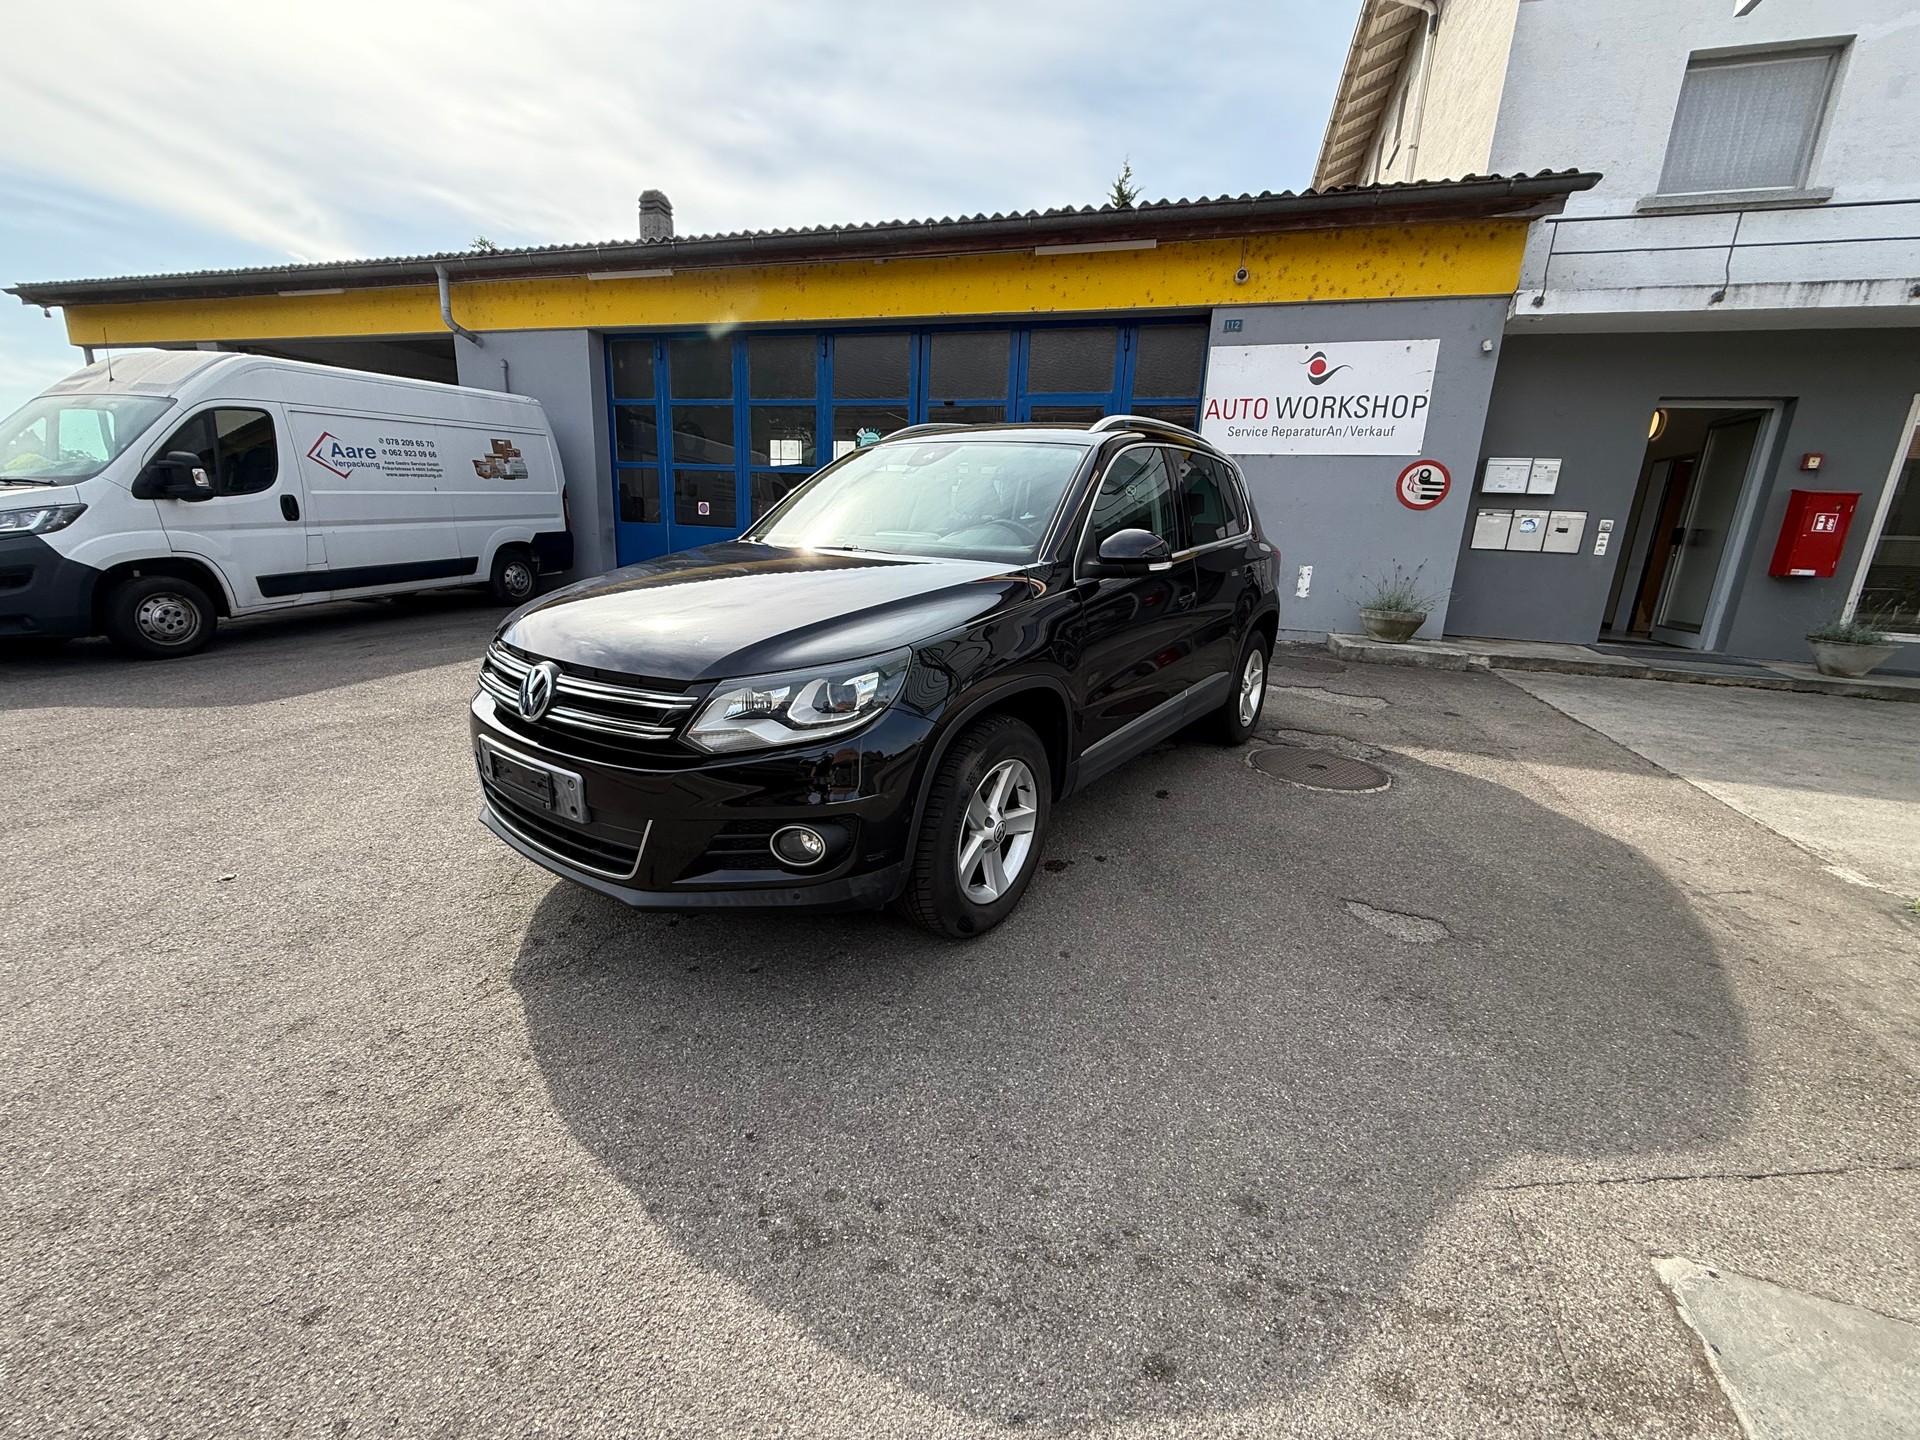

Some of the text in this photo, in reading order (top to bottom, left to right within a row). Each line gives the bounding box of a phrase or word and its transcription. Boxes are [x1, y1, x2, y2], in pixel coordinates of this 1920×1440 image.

[1226, 321, 1240, 330] 112
[1204, 394, 1428, 420] AUTO WORKSHOP
[1227, 426, 1268, 437] Service
[386, 438, 399, 446] 078
[401, 439, 414, 447] 209
[331, 442, 377, 459] Aare
[332, 459, 380, 470] Verpackung
